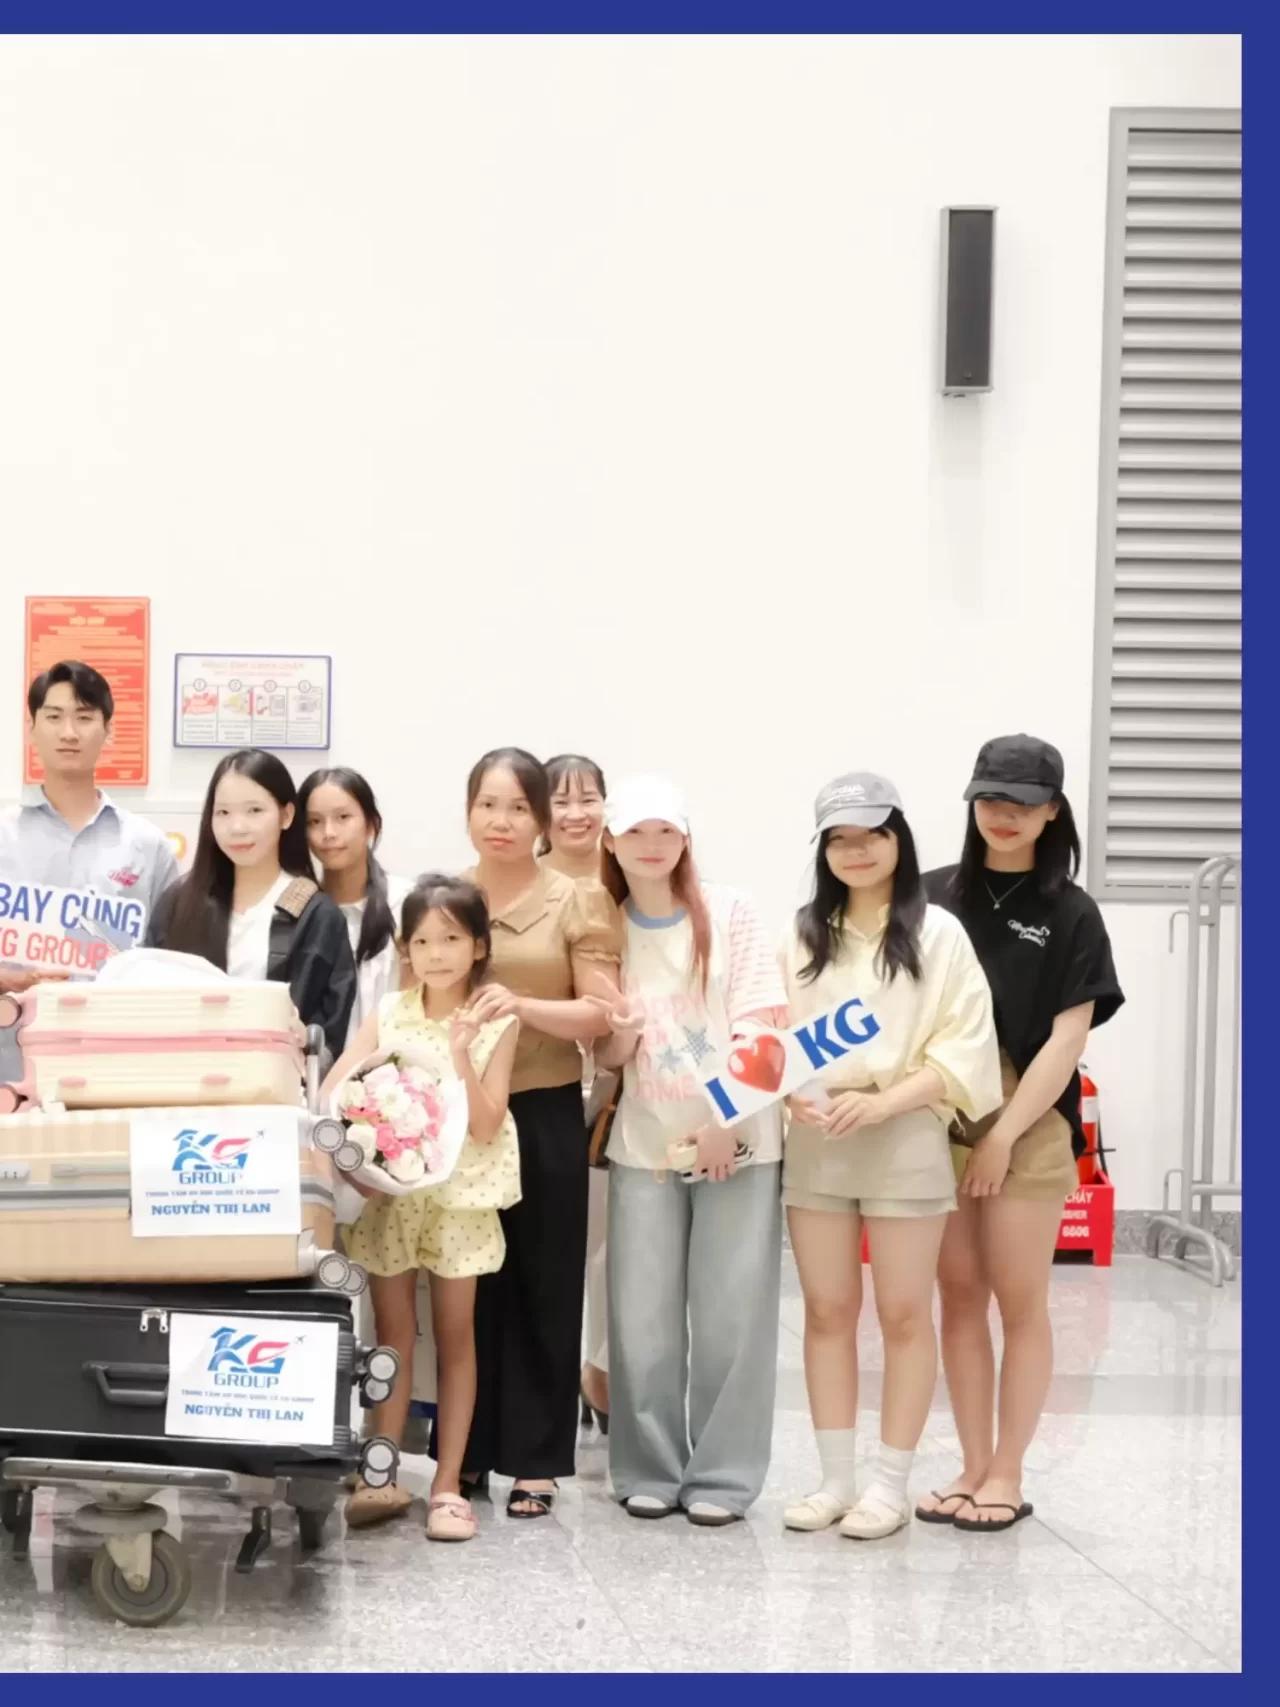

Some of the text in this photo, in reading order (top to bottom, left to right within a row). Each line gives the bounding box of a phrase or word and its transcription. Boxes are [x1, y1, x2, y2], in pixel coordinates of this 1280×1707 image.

[60, 889, 142, 939] CÙNG
[25, 932, 109, 970] GROUP
[704, 997, 881, 1121] I KG
[242, 1202, 271, 1213] LAN
[207, 1326, 290, 1374] KG
[214, 1373, 279, 1388] GROUP
[275, 1409, 304, 1421] LAN
